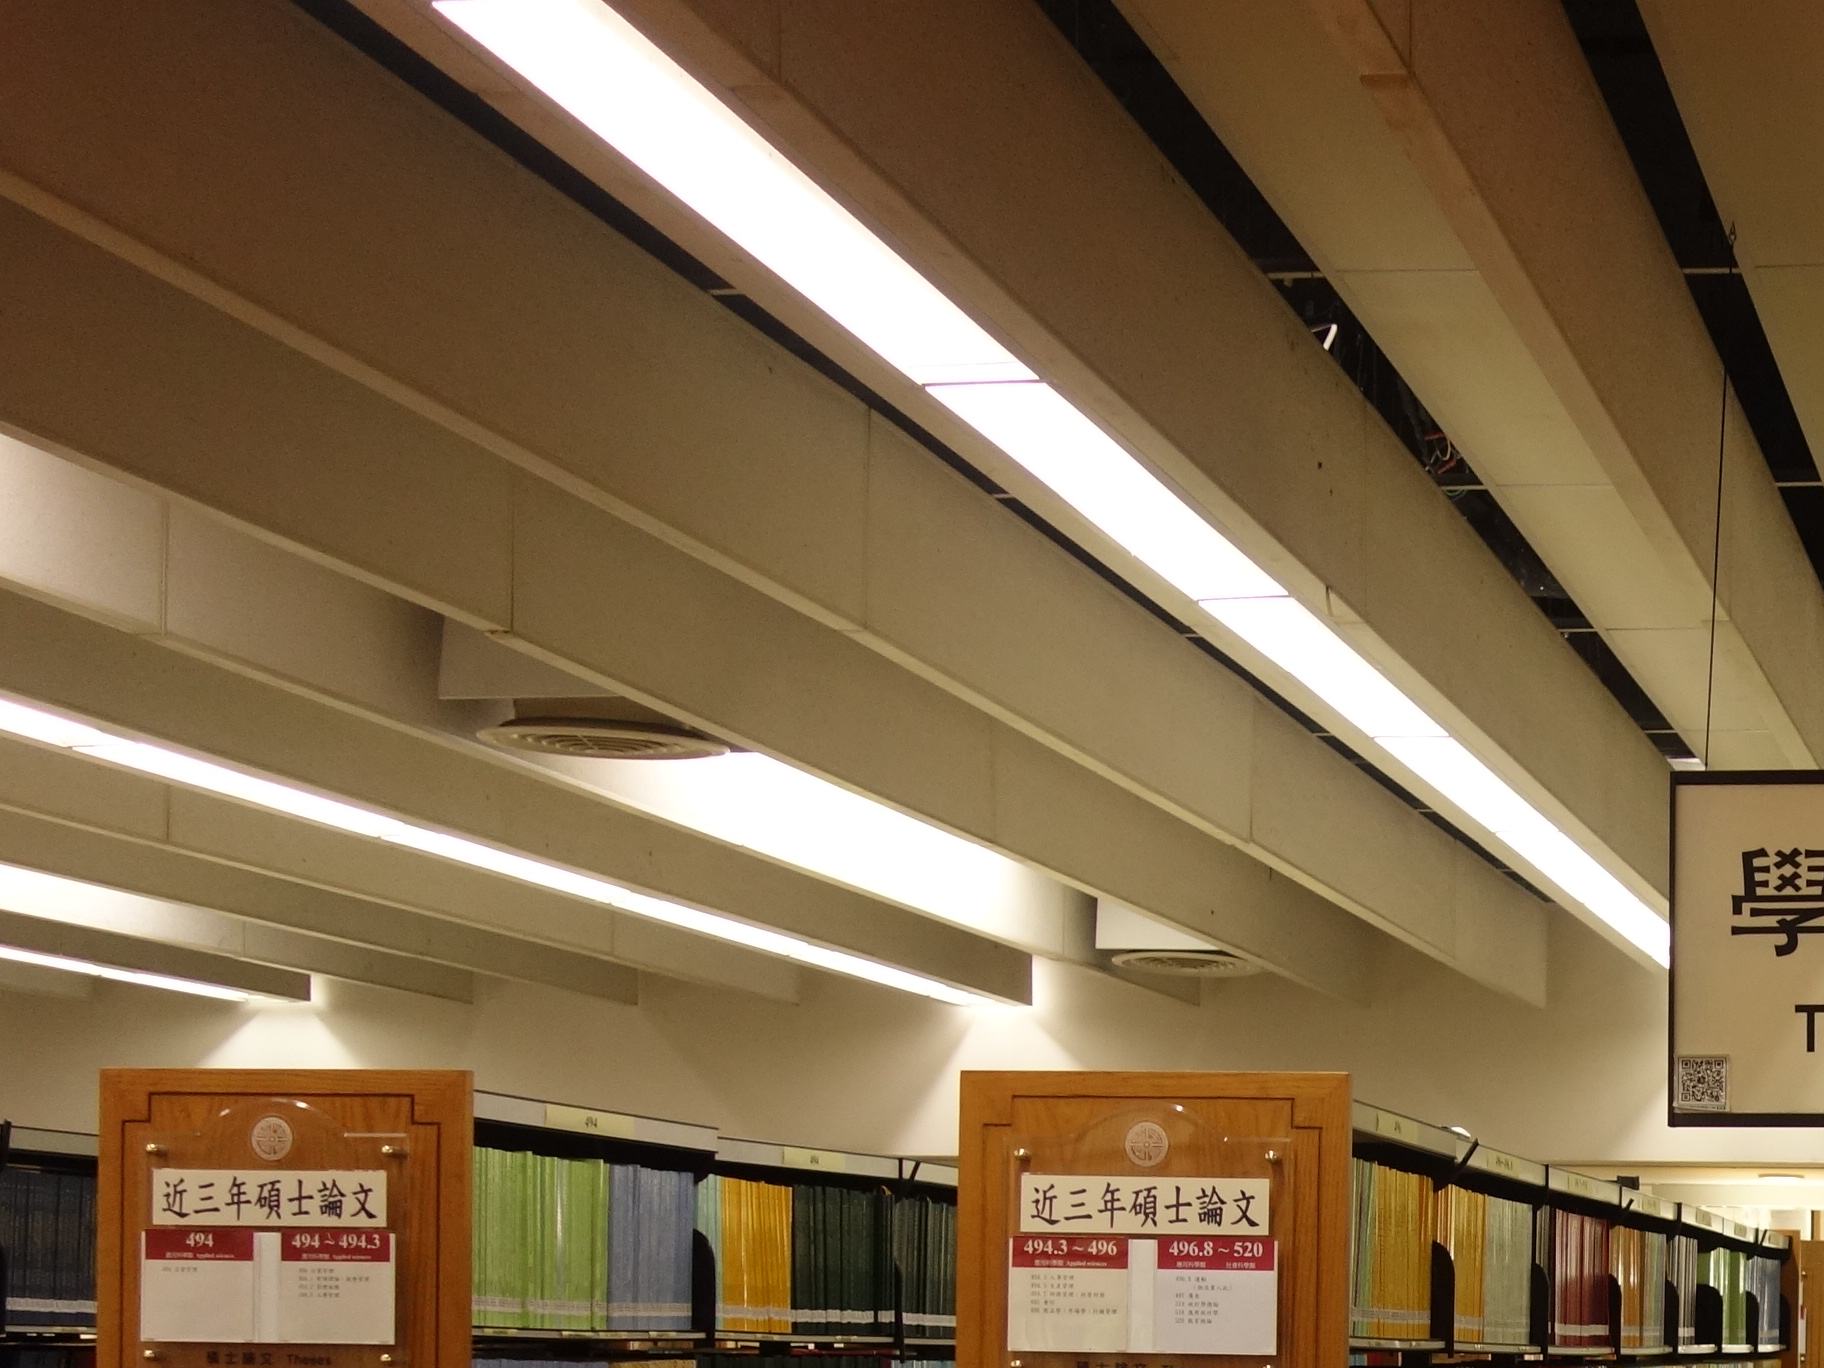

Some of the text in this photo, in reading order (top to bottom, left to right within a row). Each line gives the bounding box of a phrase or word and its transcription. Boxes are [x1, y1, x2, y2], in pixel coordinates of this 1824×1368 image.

[162, 1176, 378, 1221] 近三年碩士論文
[1030, 1182, 1260, 1229] 近三年碩士論文
[186, 1232, 214, 1248] 494
[291, 1233, 320, 1249] 494
[339, 1234, 380, 1249] 494.3
[1023, 1239, 1068, 1255] 494.3
[1087, 1240, 1118, 1256] 496
[1168, 1240, 1214, 1257] 496.8
[1233, 1241, 1263, 1258] 520
